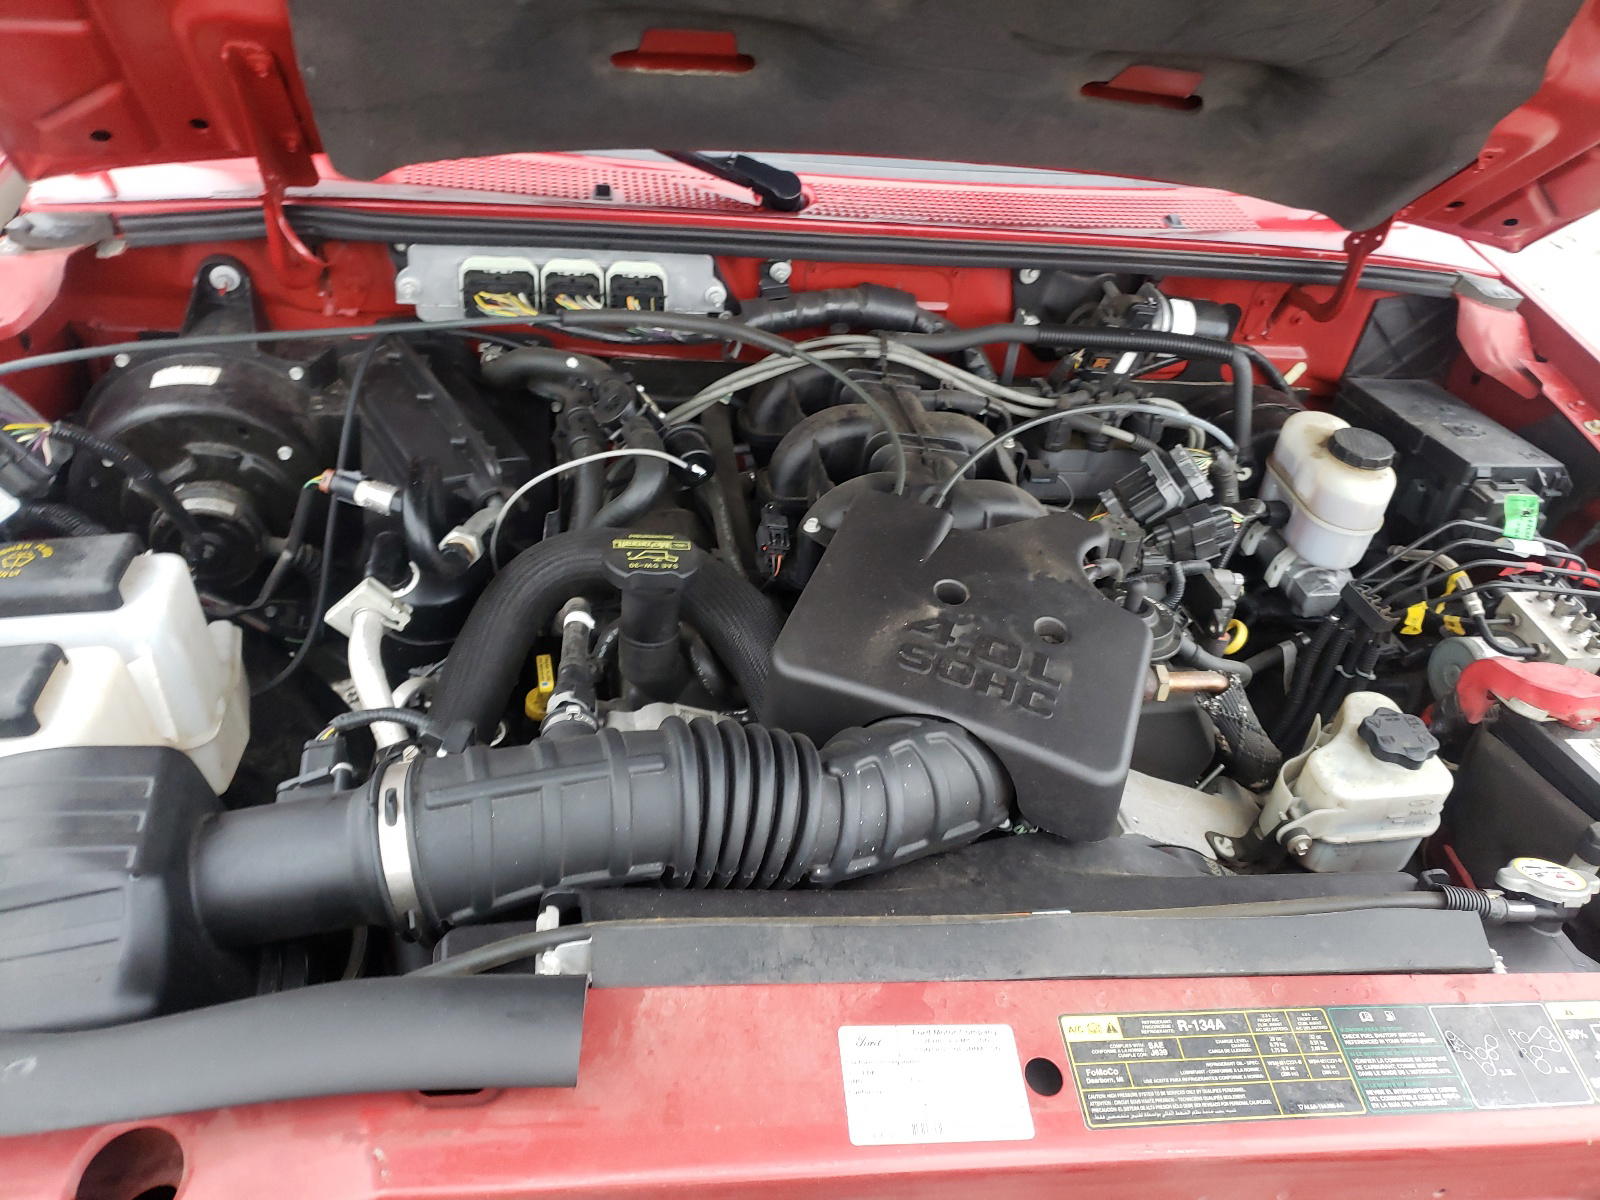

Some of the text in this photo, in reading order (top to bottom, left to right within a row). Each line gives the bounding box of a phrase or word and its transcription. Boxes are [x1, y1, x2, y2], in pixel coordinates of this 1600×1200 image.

[904, 614, 1063, 693] 4.0L
[896, 642, 1058, 720] SOHC
[1176, 1018, 1227, 1033] R-134A
[1563, 1028, 1589, 1041] 50%
[1147, 1041, 1165, 1049] SAE
[1085, 1067, 1119, 1078] FoMoCo
[1085, 1076, 1116, 1085] Dearborn,
